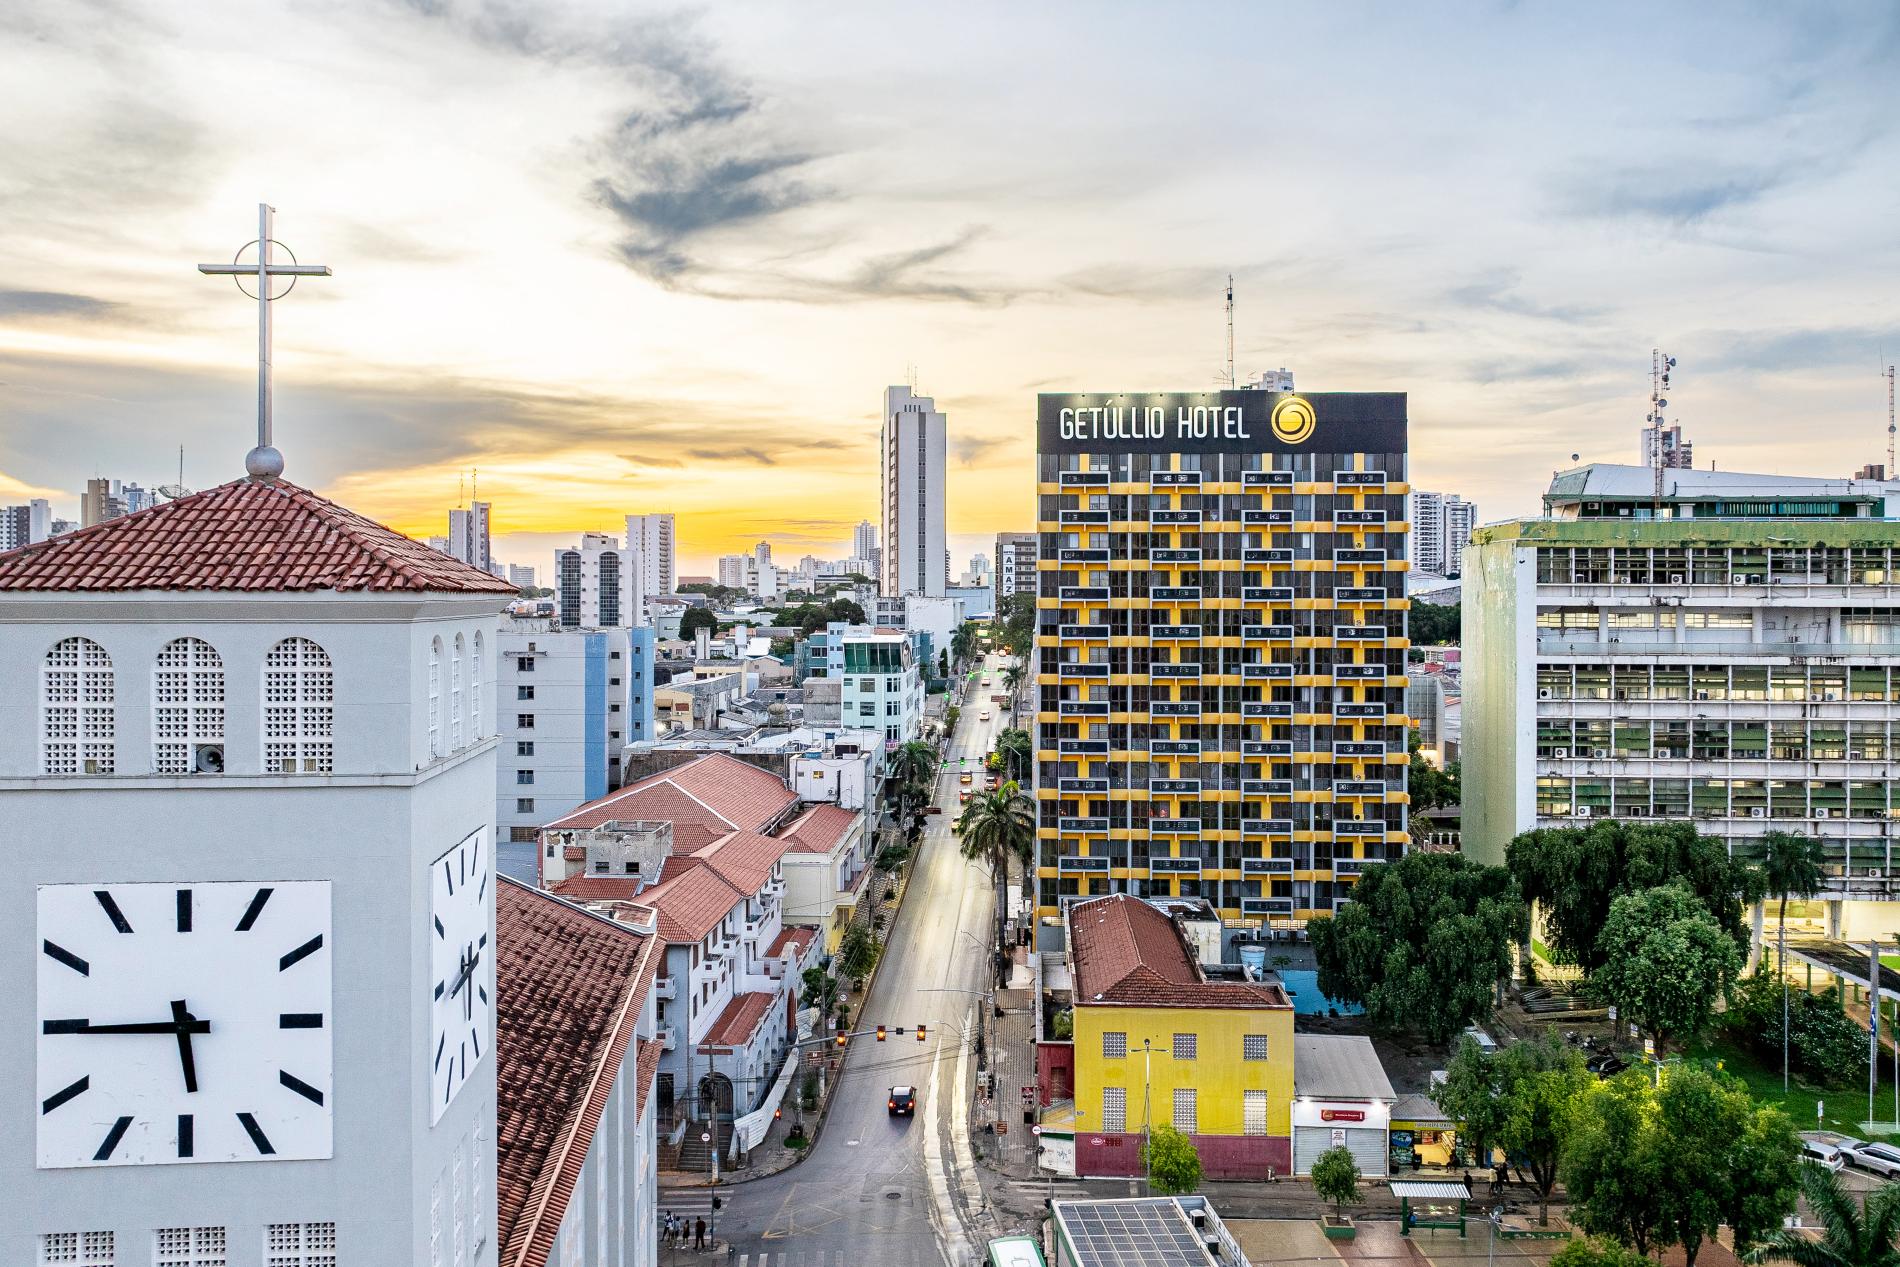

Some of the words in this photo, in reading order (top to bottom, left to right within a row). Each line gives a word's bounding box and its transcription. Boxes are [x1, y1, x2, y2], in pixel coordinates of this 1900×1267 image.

[1060, 400, 1165, 439] GETÚLLIO
[1178, 406, 1251, 439] HOTEL
[1005, 556, 1013, 593] AMAZ
